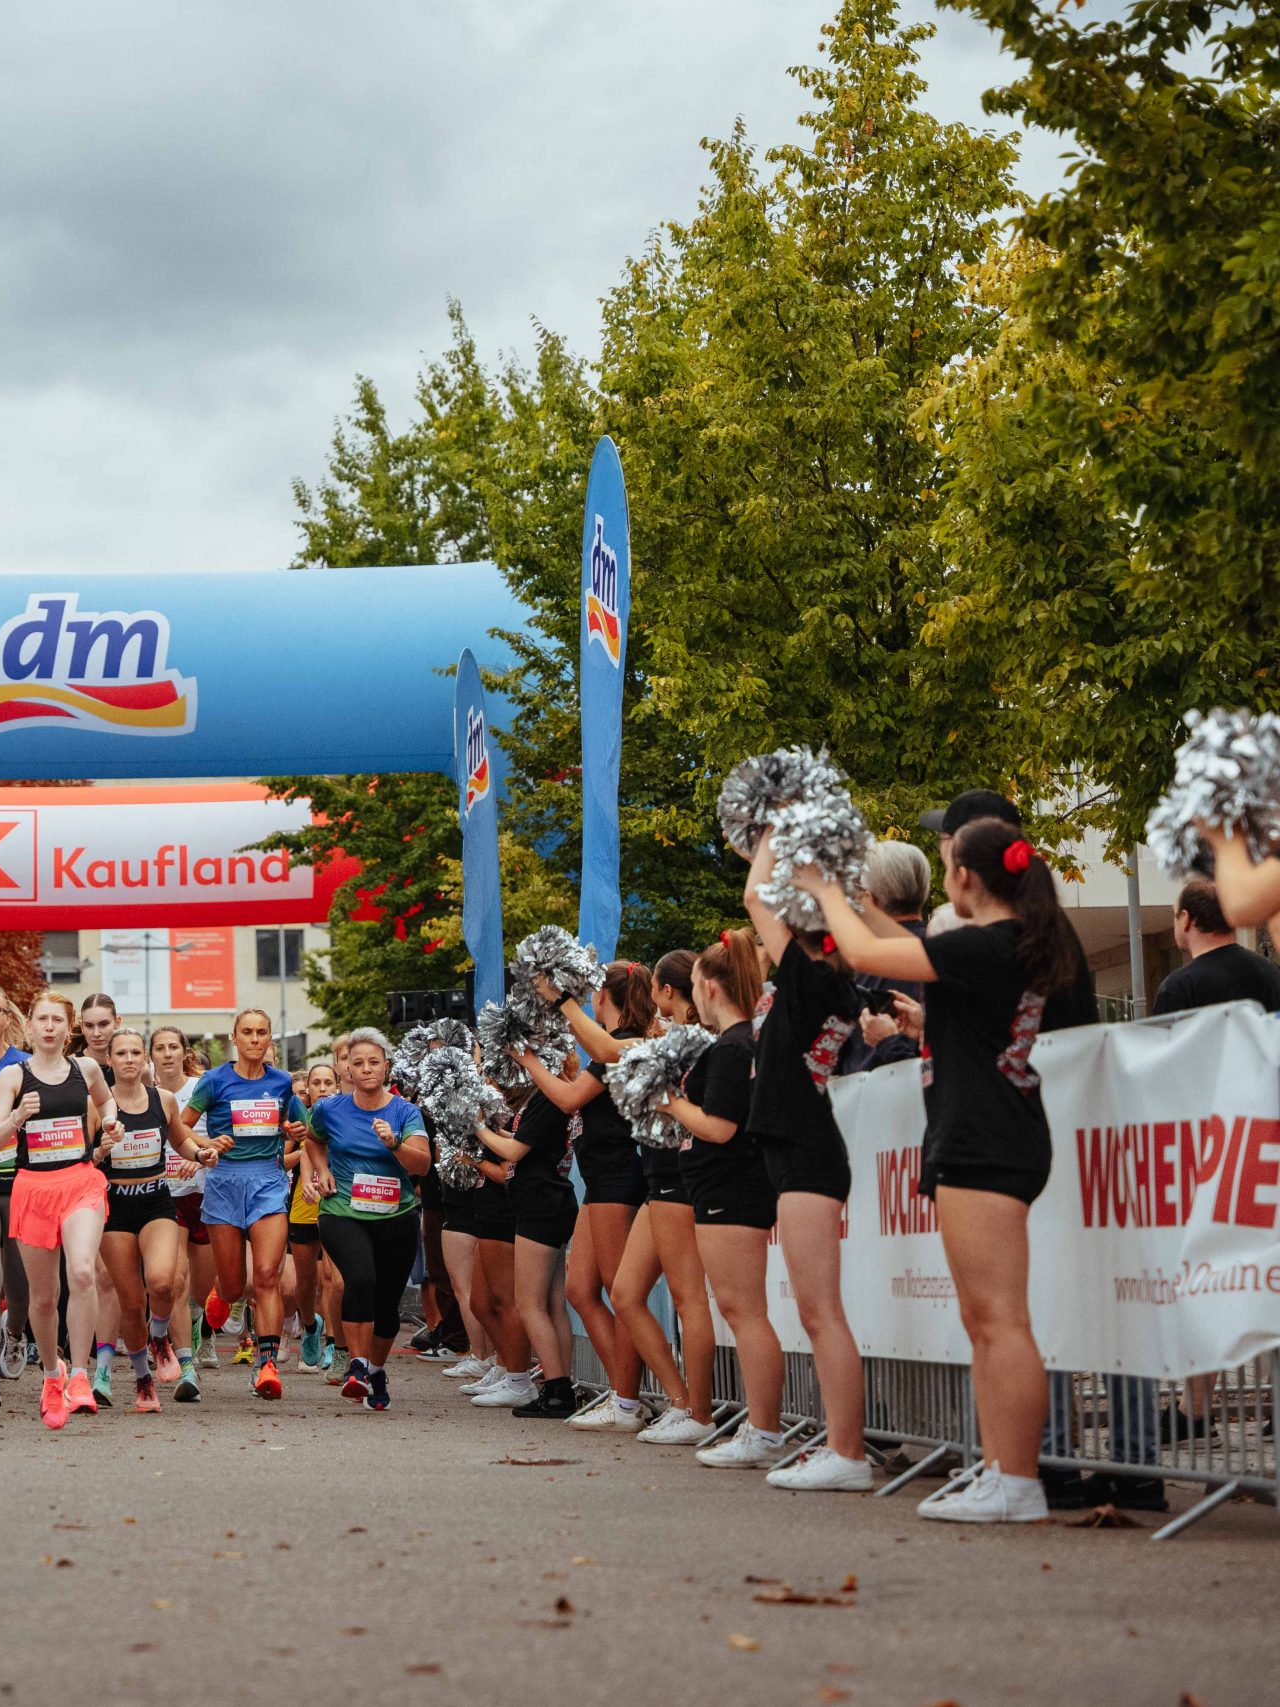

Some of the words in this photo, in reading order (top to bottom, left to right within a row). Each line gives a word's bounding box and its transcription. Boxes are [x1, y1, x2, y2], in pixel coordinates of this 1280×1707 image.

[592, 523, 616, 612] dm
[2, 599, 160, 681] dm
[467, 713, 484, 776] dm
[53, 844, 290, 889] Kaufland
[242, 1110, 271, 1120] Conny
[38, 1130, 74, 1142] Janina
[123, 1142, 150, 1151] Elena
[116, 1181, 156, 1196] NIKE
[360, 1185, 394, 1196] Jessica
